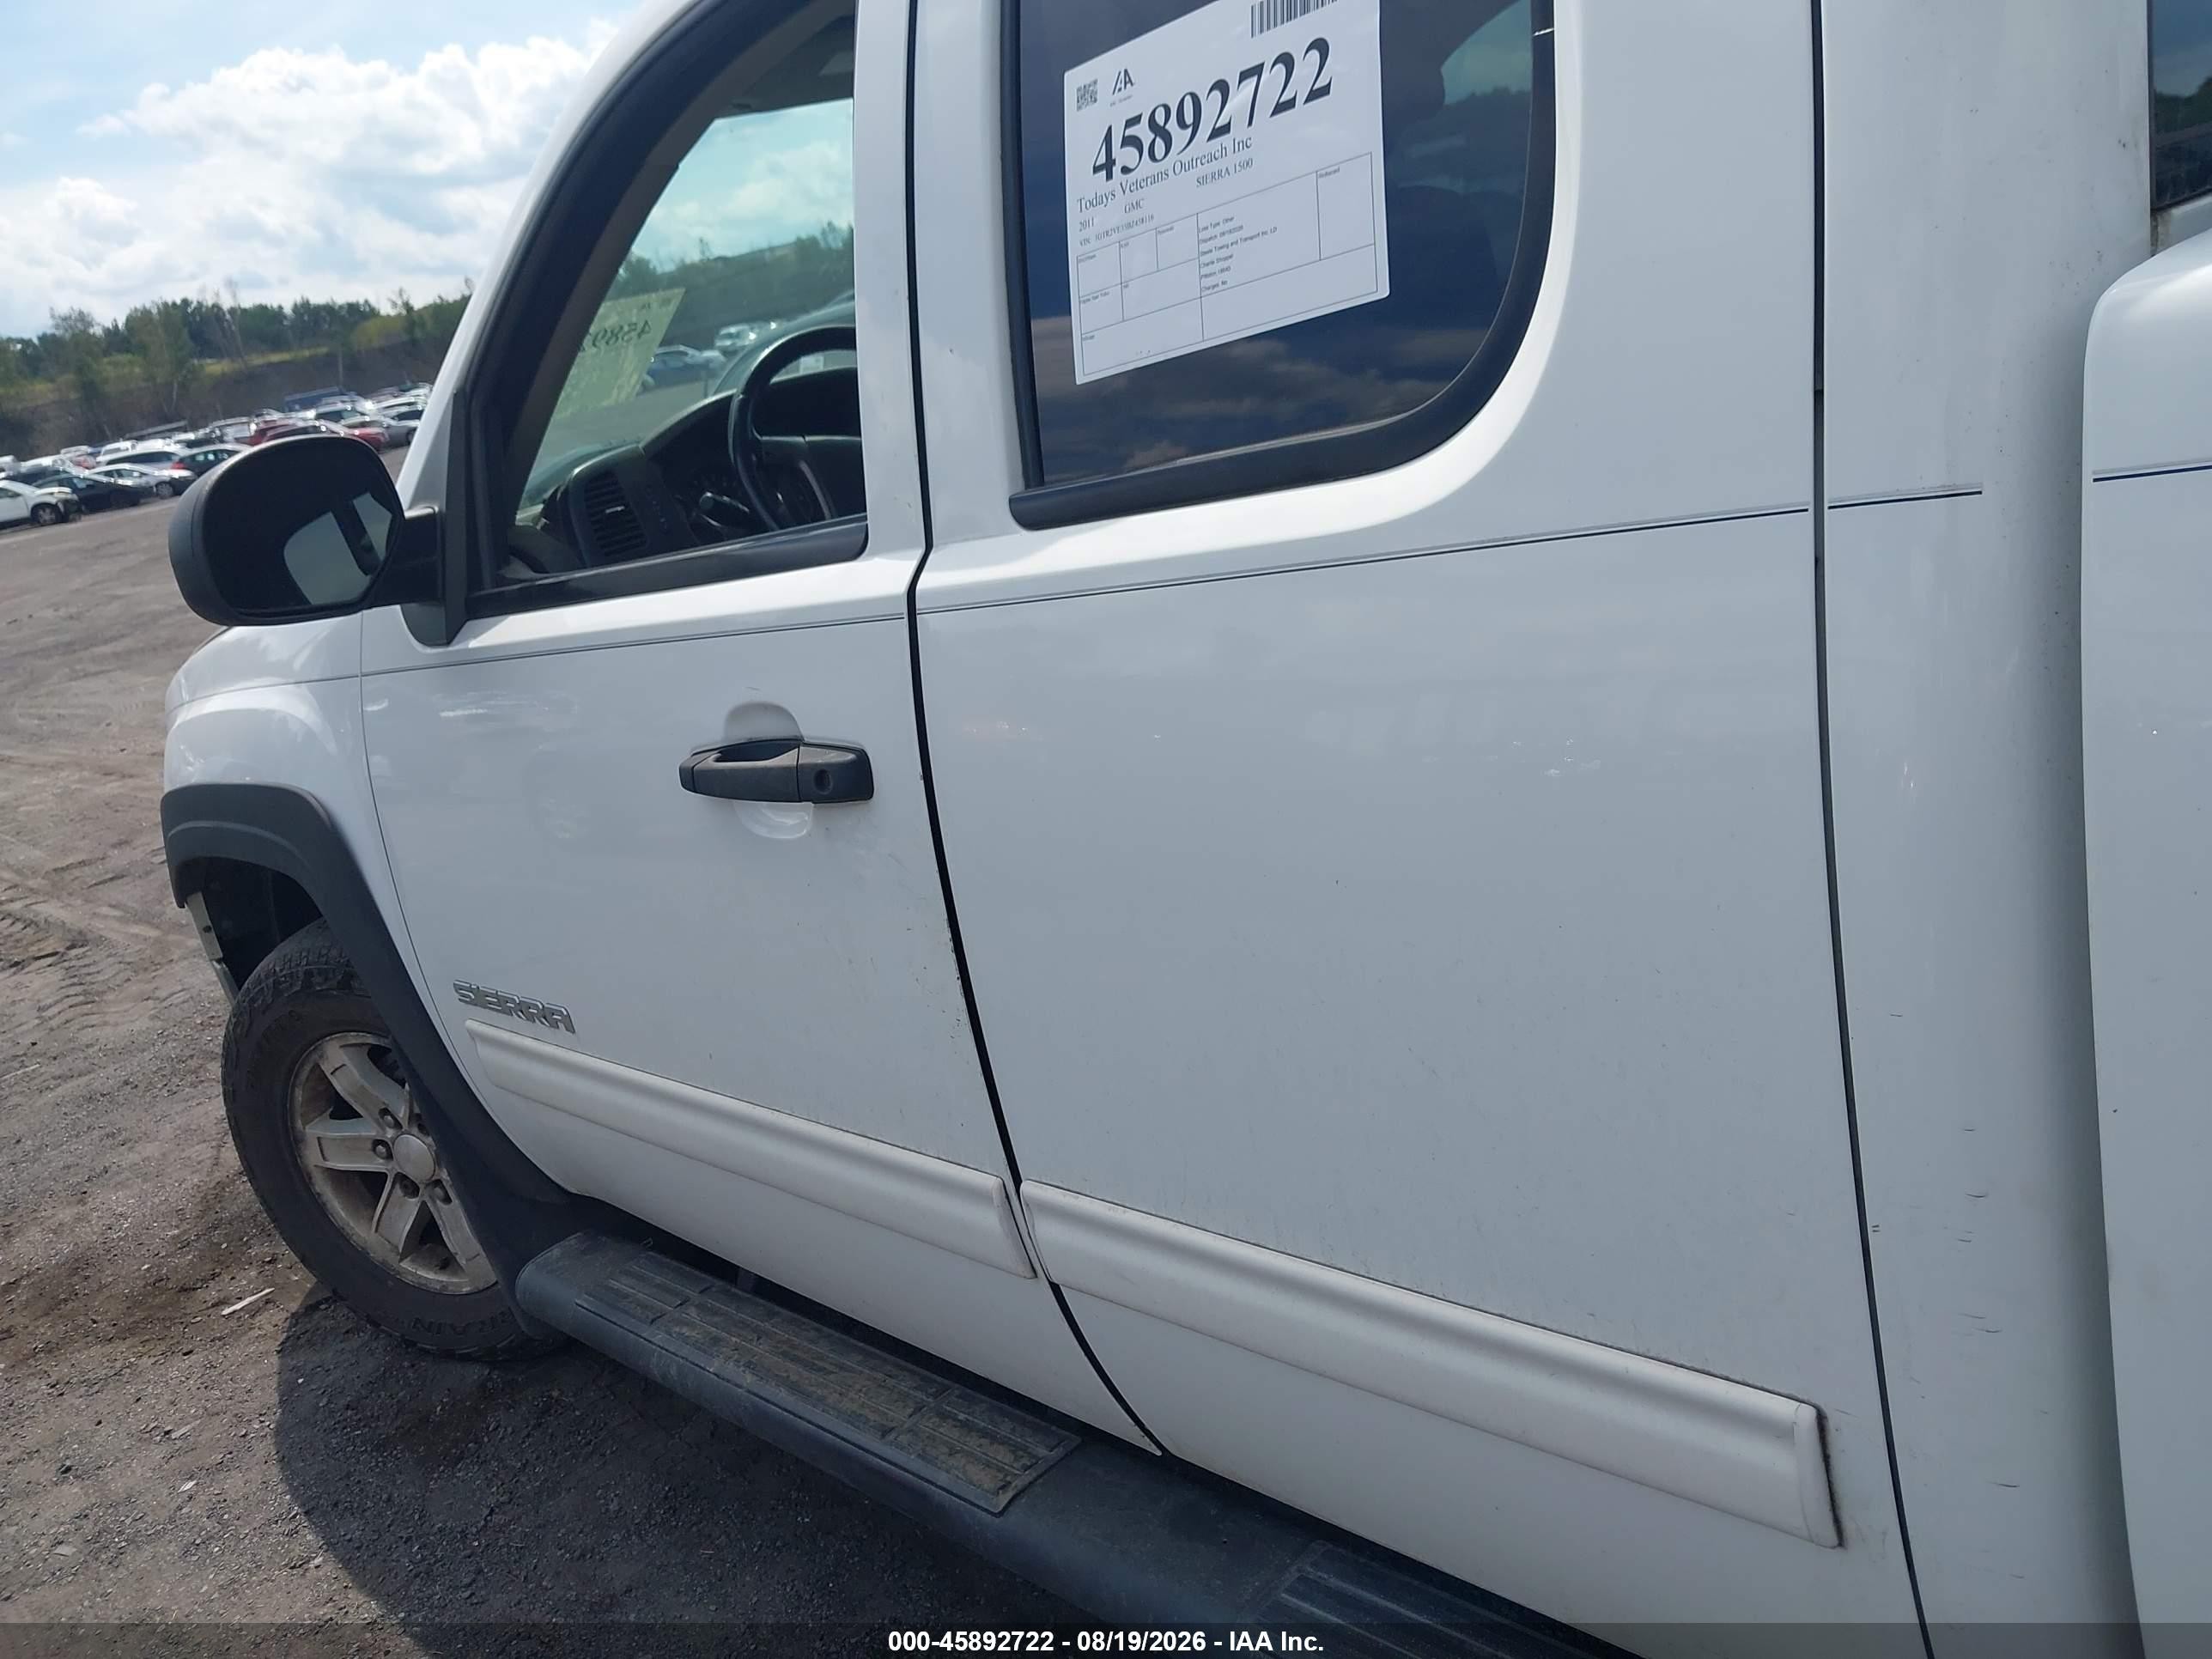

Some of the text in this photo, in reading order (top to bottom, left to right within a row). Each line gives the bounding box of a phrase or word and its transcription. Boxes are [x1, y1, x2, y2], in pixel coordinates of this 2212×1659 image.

[1092, 37, 1333, 182] 45892722
[1077, 137, 1253, 213] Todays Veterans Outreach Inc
[1195, 157, 1255, 188] SIERRA 1500
[1079, 198, 1146, 232] 2011 GMC
[453, 979, 576, 1034] SIERRA
